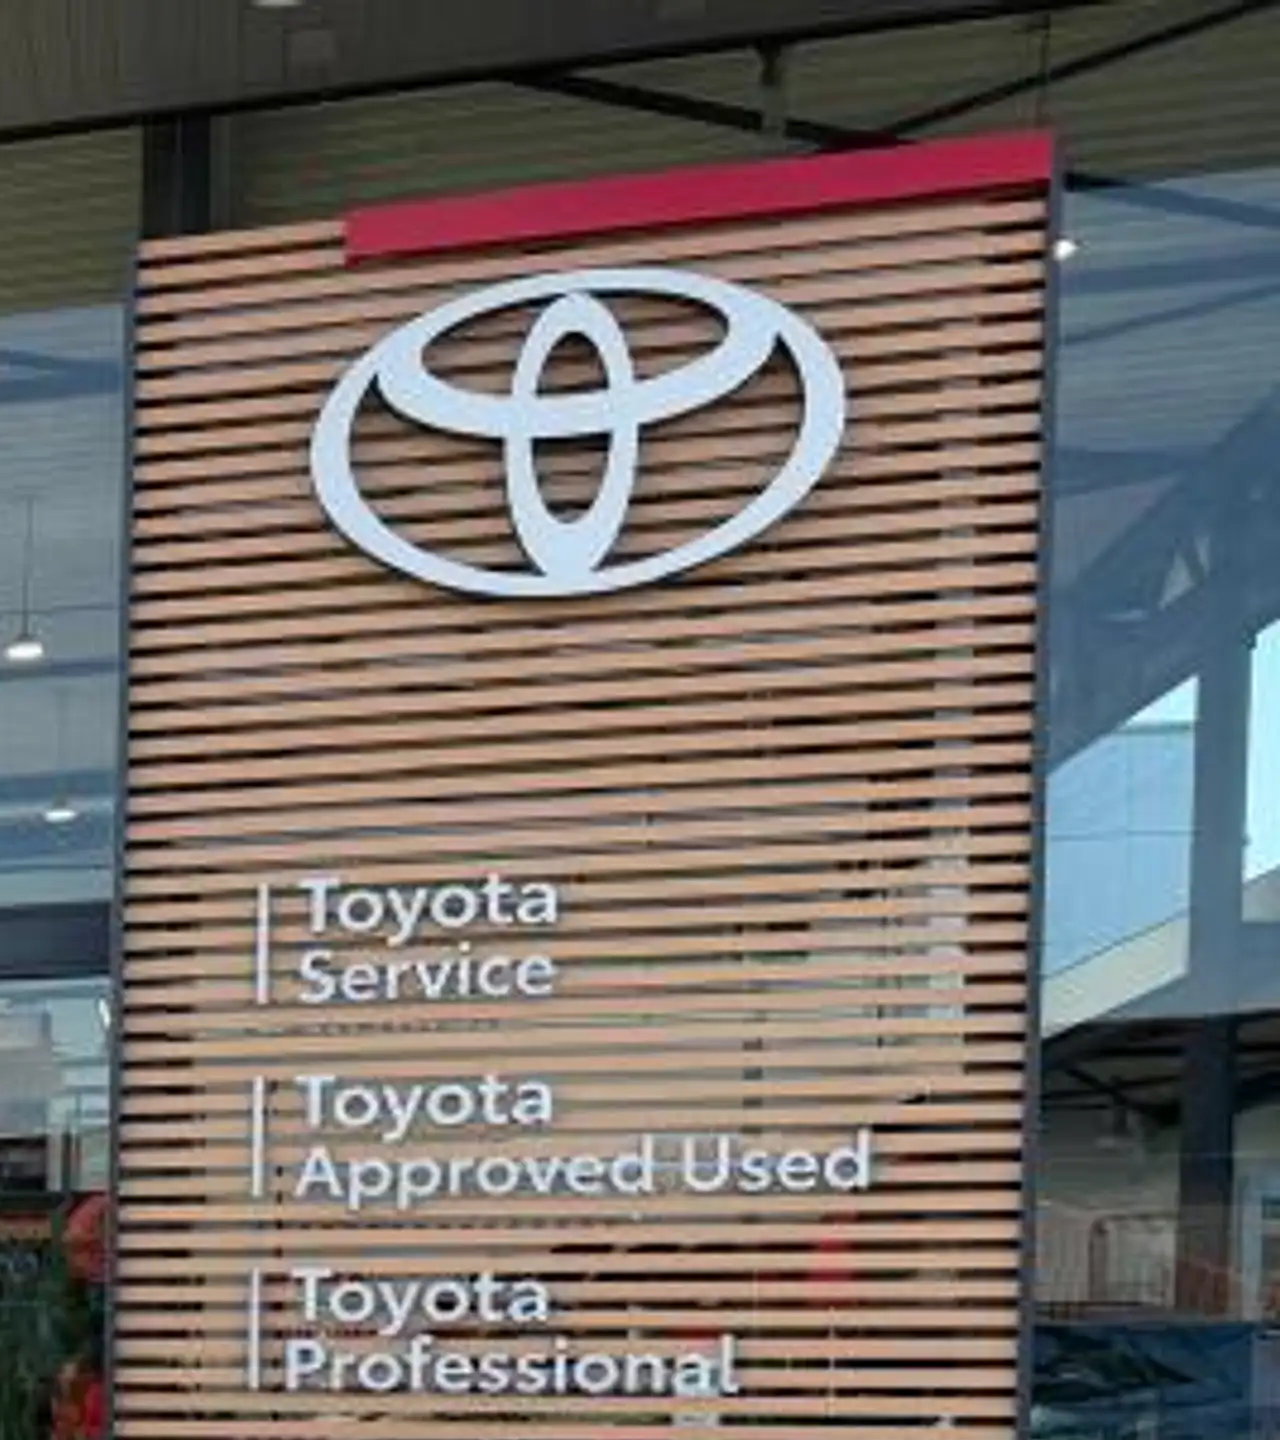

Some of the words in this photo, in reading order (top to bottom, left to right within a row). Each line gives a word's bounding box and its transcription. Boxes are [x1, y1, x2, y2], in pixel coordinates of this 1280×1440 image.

[300, 873, 560, 946] Toyota
[299, 942, 558, 1004] Service
[295, 1073, 554, 1142] Toyota
[294, 1134, 654, 1210] Approved
[683, 1129, 872, 1192] Used
[290, 1266, 549, 1336] Toyota
[284, 1334, 740, 1396] Professional
